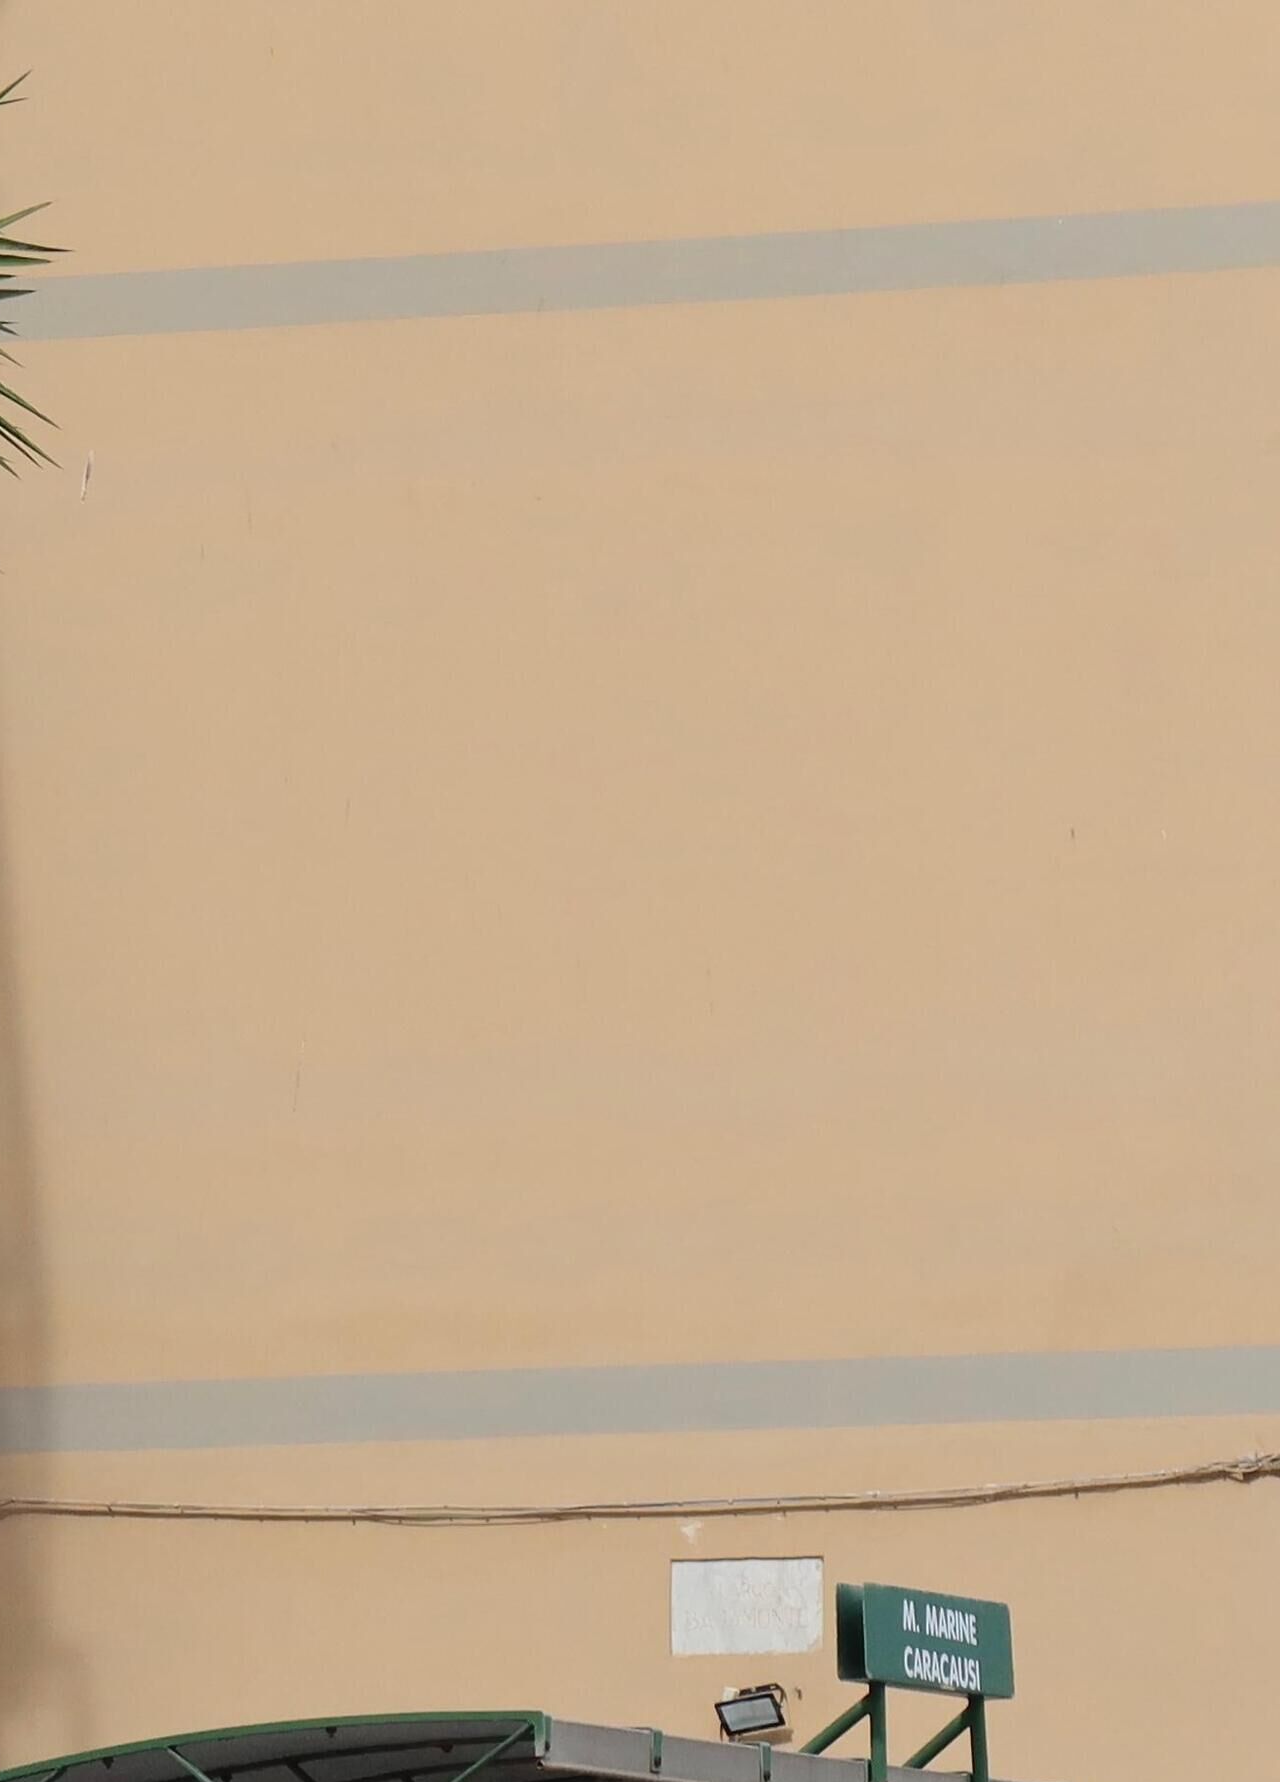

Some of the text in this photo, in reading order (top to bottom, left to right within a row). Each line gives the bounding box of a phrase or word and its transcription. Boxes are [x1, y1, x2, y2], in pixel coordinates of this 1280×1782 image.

[903, 1599, 978, 1646] M. MARINE
[904, 1645, 981, 1692] CARACAUSI
